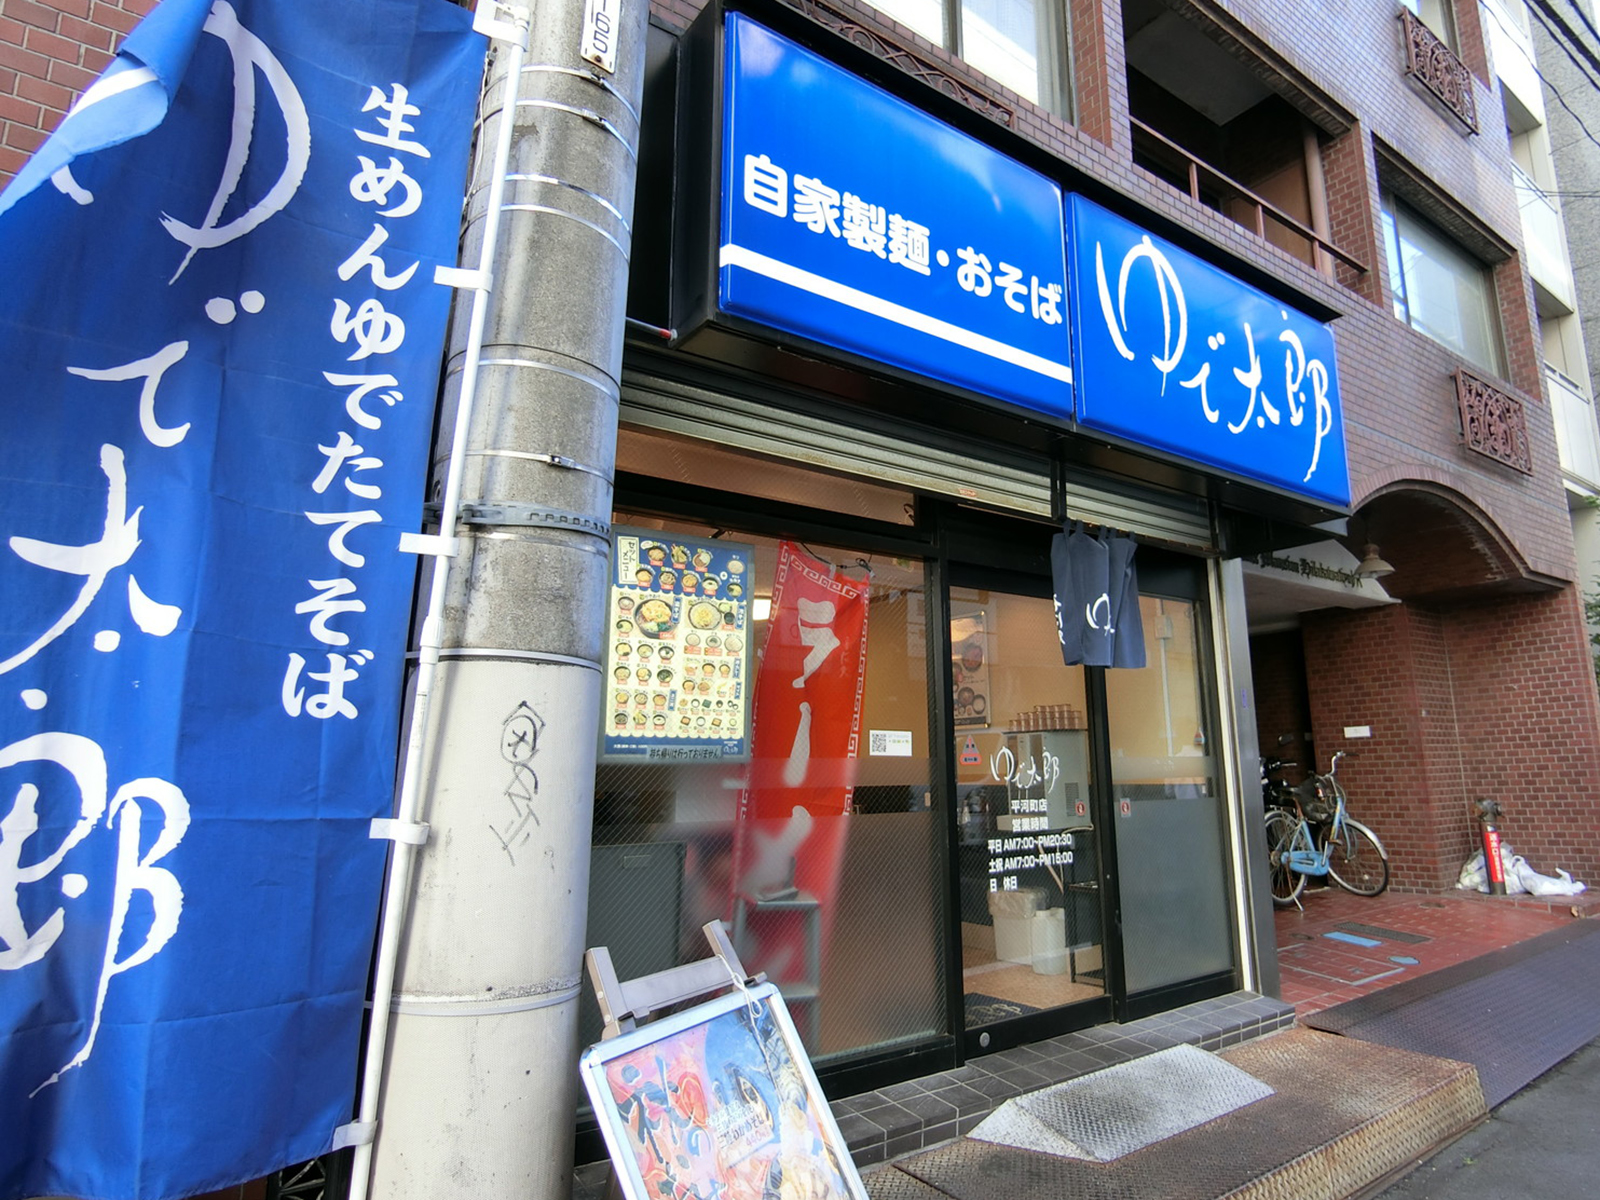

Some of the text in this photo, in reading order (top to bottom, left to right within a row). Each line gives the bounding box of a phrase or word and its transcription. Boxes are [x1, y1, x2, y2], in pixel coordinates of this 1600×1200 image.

[743, 153, 1063, 325] 自家製麺・おそば
[283, 84, 431, 720] 生めんゆでたてそば
[1095, 235, 1332, 482] ゆで太郎
[989, 746, 1060, 794] ゆで太郎
[1012, 816, 1049, 832] 営業時間
